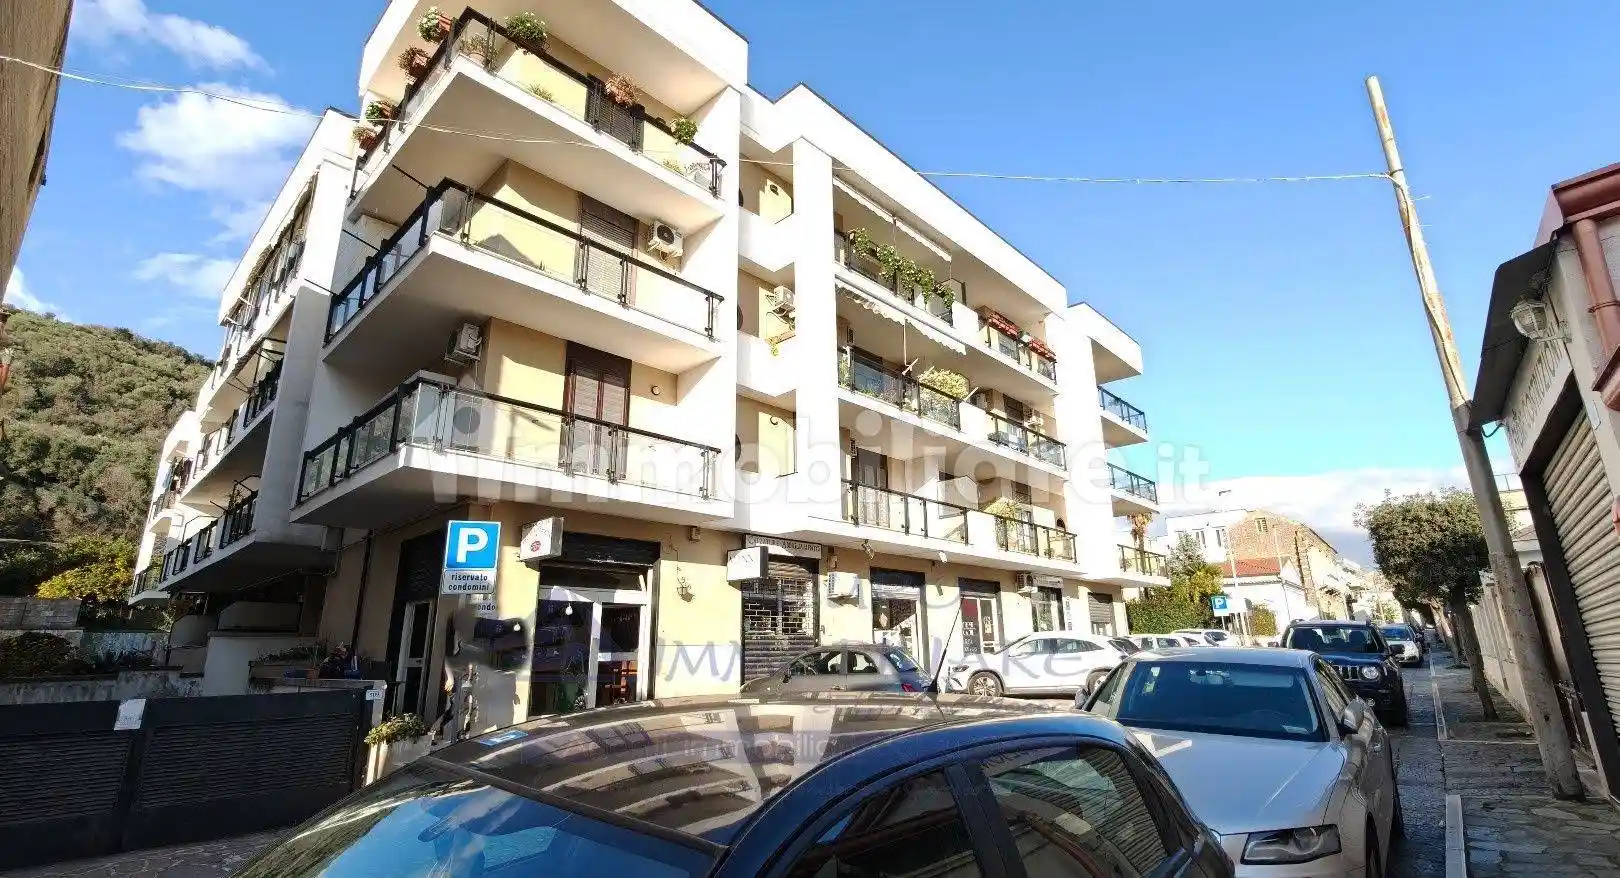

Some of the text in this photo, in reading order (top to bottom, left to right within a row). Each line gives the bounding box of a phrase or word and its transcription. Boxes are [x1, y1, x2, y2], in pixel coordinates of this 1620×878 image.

[456, 527, 489, 563] P
[451, 573, 488, 582] riservato
[448, 582, 490, 591] condomini
